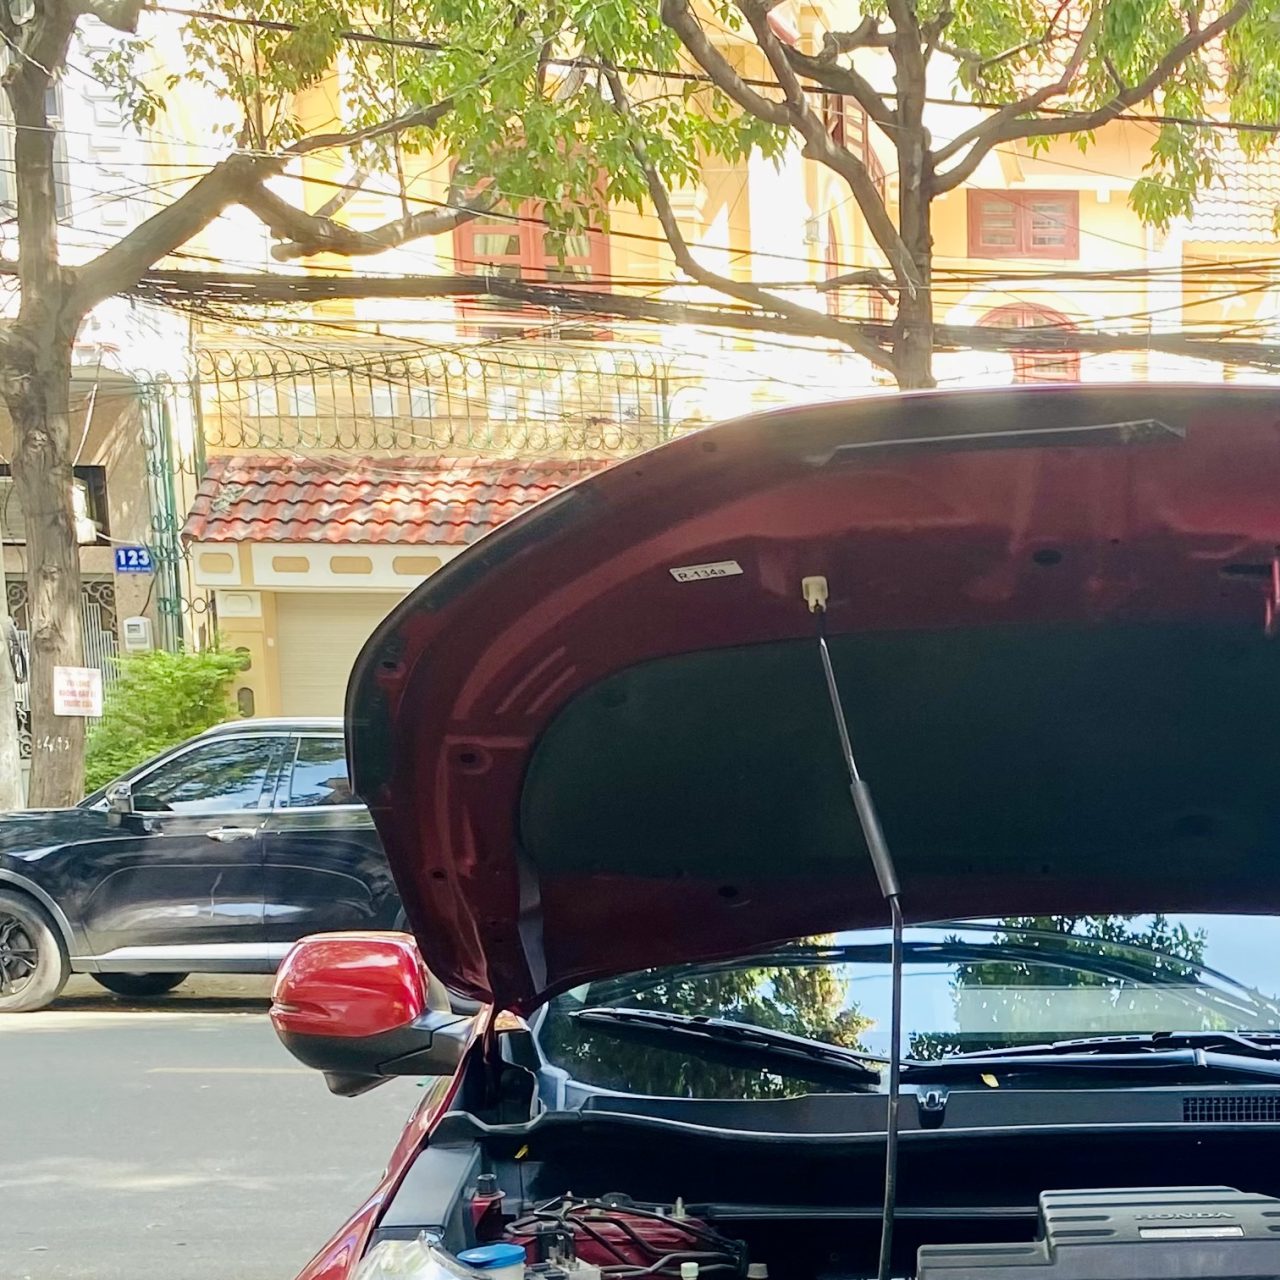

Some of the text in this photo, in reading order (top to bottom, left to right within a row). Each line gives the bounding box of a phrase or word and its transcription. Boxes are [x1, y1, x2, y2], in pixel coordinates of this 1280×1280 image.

[117, 549, 150, 566] 123
[678, 568, 726, 580] R-134a
[1134, 1212, 1235, 1221] HONDA
